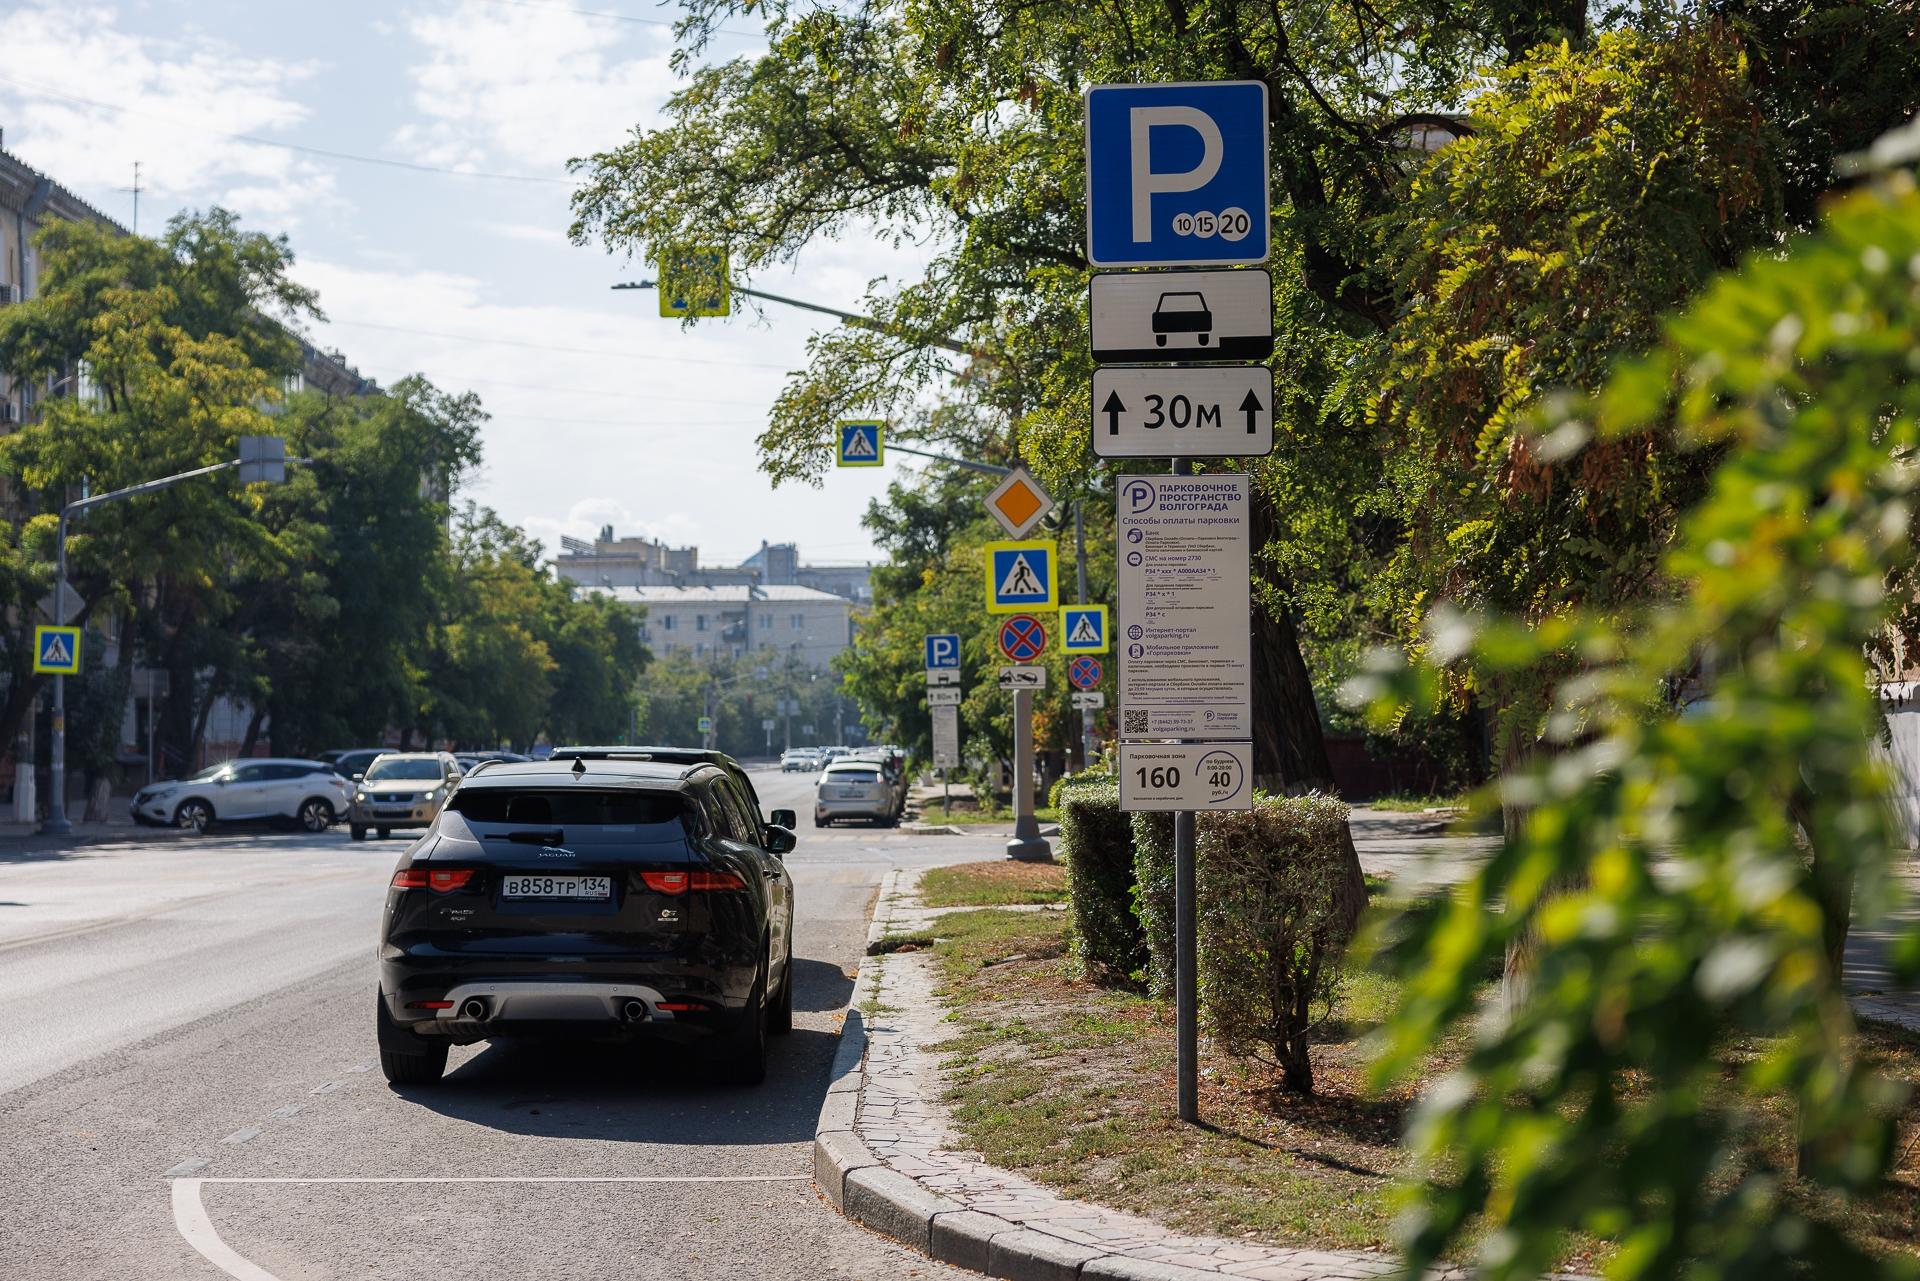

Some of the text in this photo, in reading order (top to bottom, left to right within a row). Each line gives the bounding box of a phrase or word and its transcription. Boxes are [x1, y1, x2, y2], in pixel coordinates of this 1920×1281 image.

[1130, 106, 1224, 243] P
[1177, 214, 1249, 234] 10 15 20
[1143, 394, 1222, 429] 30м
[1159, 484, 1237, 492] ПАРКОВОЧНОЕ
[1159, 493, 1242, 502] ПРОСТРАНСТВО
[1159, 503, 1229, 512] ВОЛГОГРАДА
[1122, 517, 1160, 525] Способы
[1198, 517, 1240, 526] парковки
[933, 639, 952, 666] P
[1136, 766, 1181, 789] 160
[1209, 772, 1231, 787] 40
[509, 878, 607, 894] В858ТР 134
